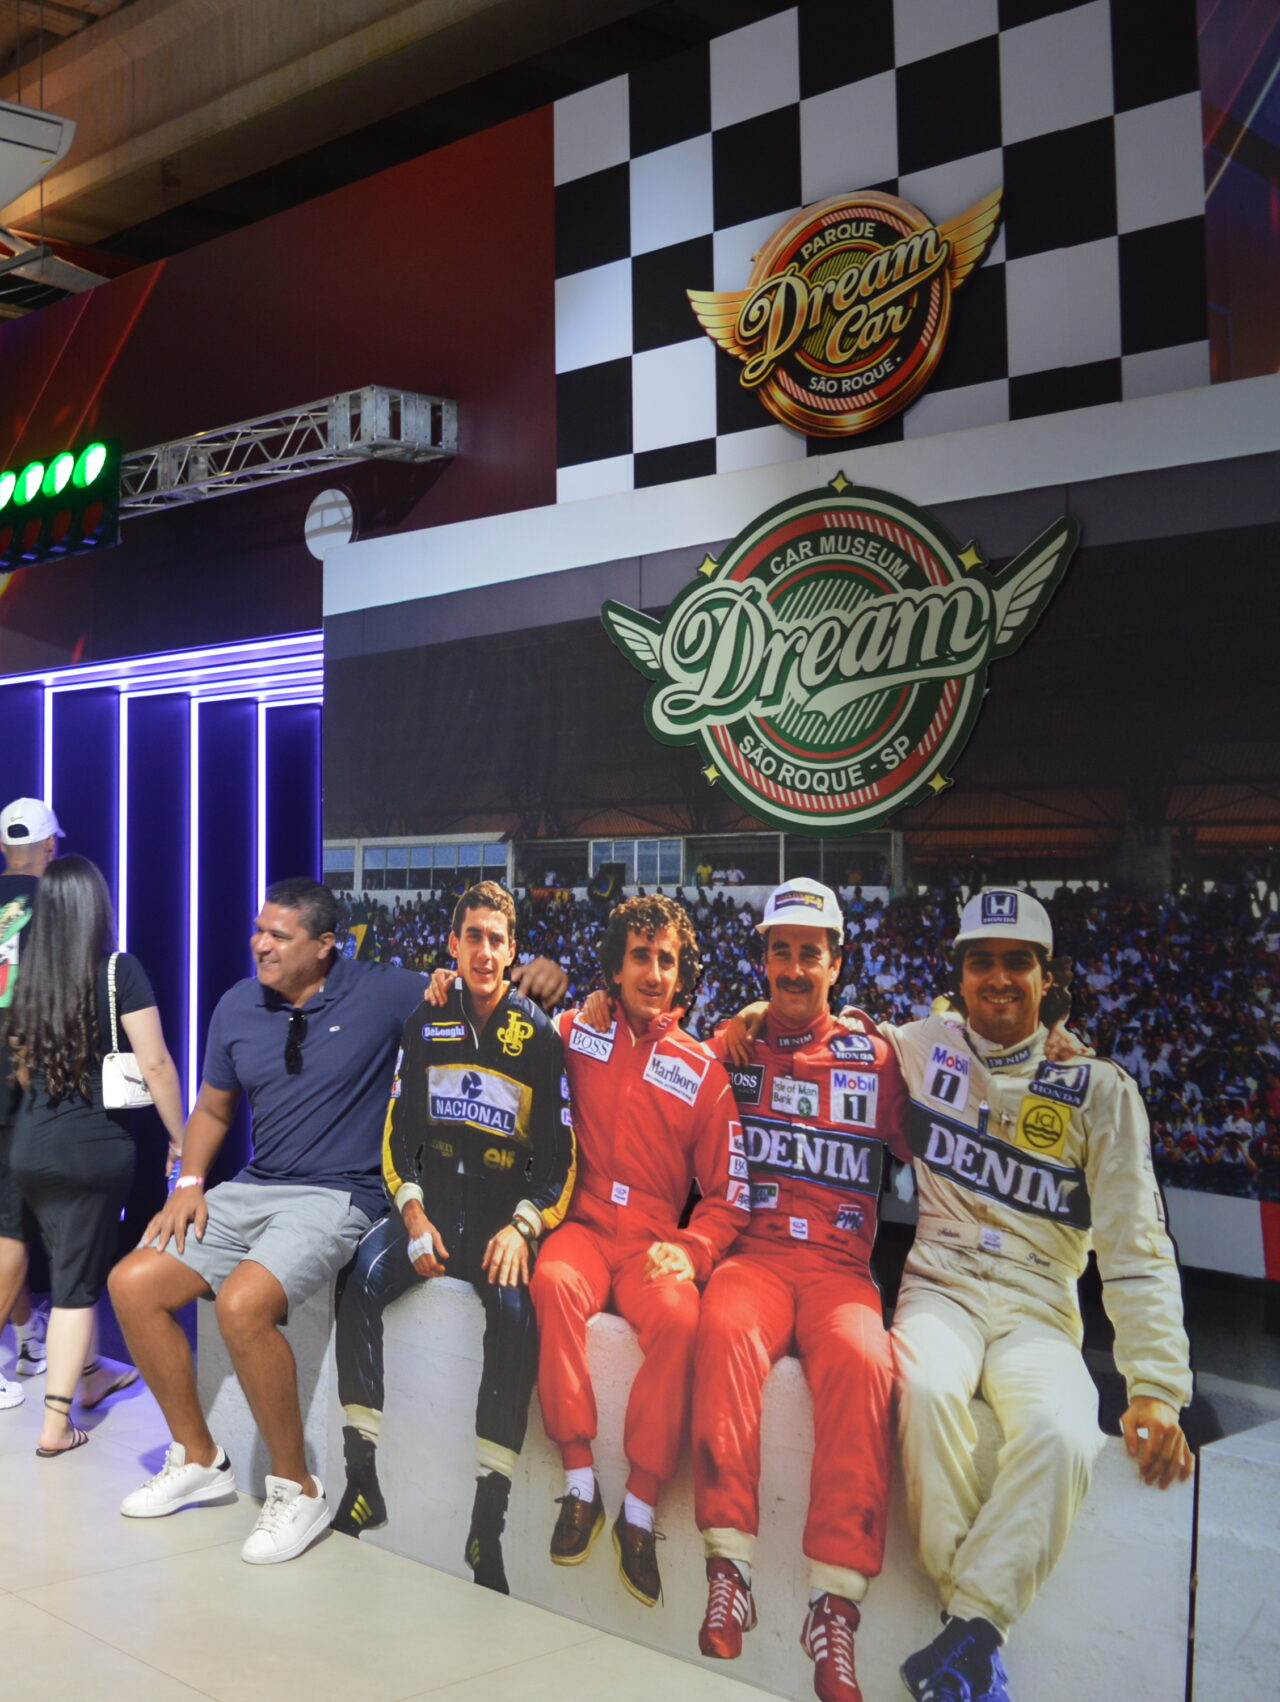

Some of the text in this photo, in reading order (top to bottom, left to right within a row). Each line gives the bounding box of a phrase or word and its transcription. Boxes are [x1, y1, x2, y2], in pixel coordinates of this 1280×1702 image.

[801, 222, 876, 260] PARQUE
[738, 227, 947, 386] Dream
[825, 301, 915, 364] Car
[809, 359, 894, 394] SÃO ROQUE
[770, 536, 910, 581] CAR MUSEUM
[657, 582, 990, 725] Dream
[738, 734, 777, 775] SÃO
[777, 762, 866, 793] ROQUE
[880, 734, 911, 772] SP
[424, 1025, 465, 1038] DeLonghi
[572, 1030, 610, 1056] BOSS
[836, 1052, 875, 1061] HONDA
[932, 1047, 969, 1075] Mobil
[988, 1050, 1030, 1067] DENIM
[650, 1057, 699, 1095] Marlboro
[798, 1084, 817, 1096] Man
[833, 1073, 876, 1092] Mobil
[939, 1074, 953, 1099] 1
[848, 1096, 859, 1120] 1
[1031, 1083, 1081, 1105] HONDA
[436, 1099, 512, 1131] NACIONAL
[1035, 1111, 1056, 1129] ICI
[483, 1147, 517, 1168] elf
[745, 1126, 872, 1183] DENIM
[924, 1122, 1079, 1213] DENIM
